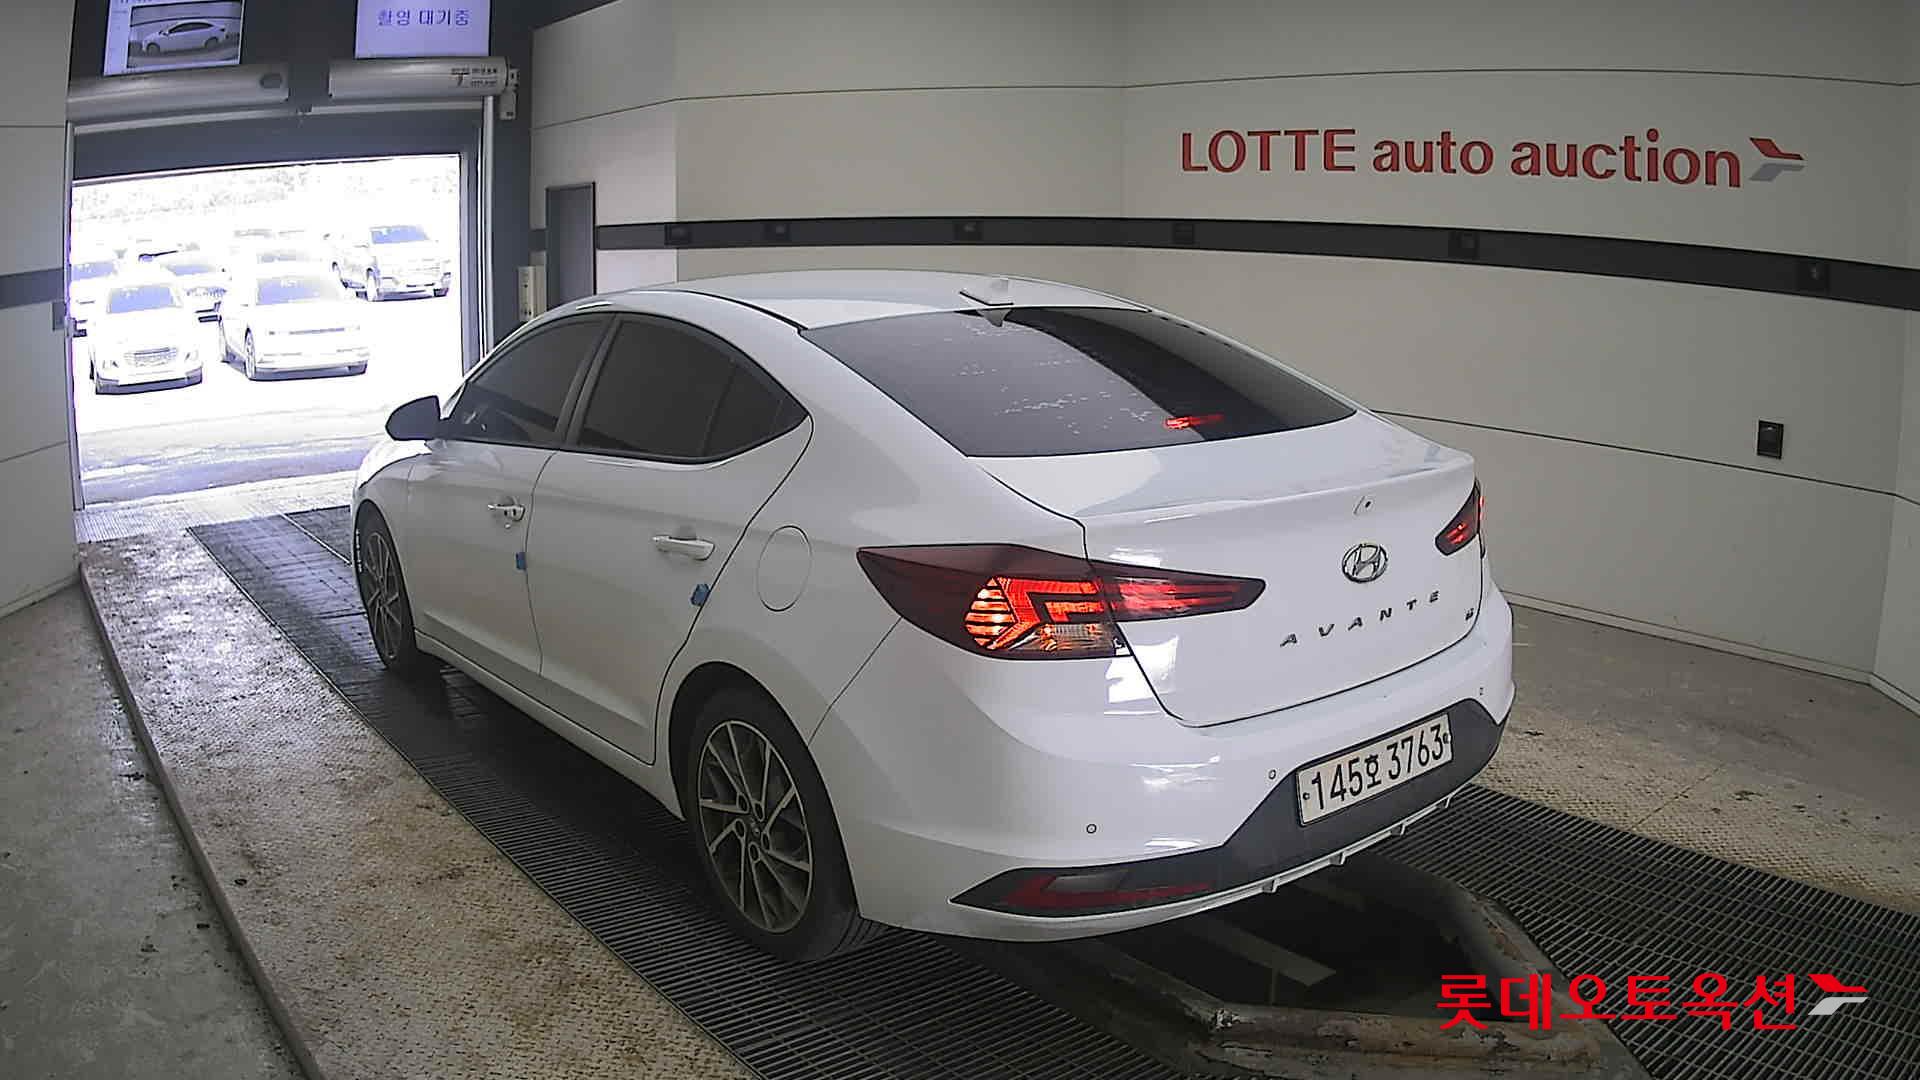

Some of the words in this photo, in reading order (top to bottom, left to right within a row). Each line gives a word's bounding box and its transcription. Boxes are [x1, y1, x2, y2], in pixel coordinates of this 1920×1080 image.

[419, 8, 469, 26] 대기중
[1181, 128, 1357, 173] LOTTE
[1372, 130, 1495, 175] auto
[1510, 128, 1742, 188] auction
[1279, 590, 1440, 647] AVANTE
[1312, 754, 1382, 810] 145호
[1387, 723, 1444, 780] 3763
